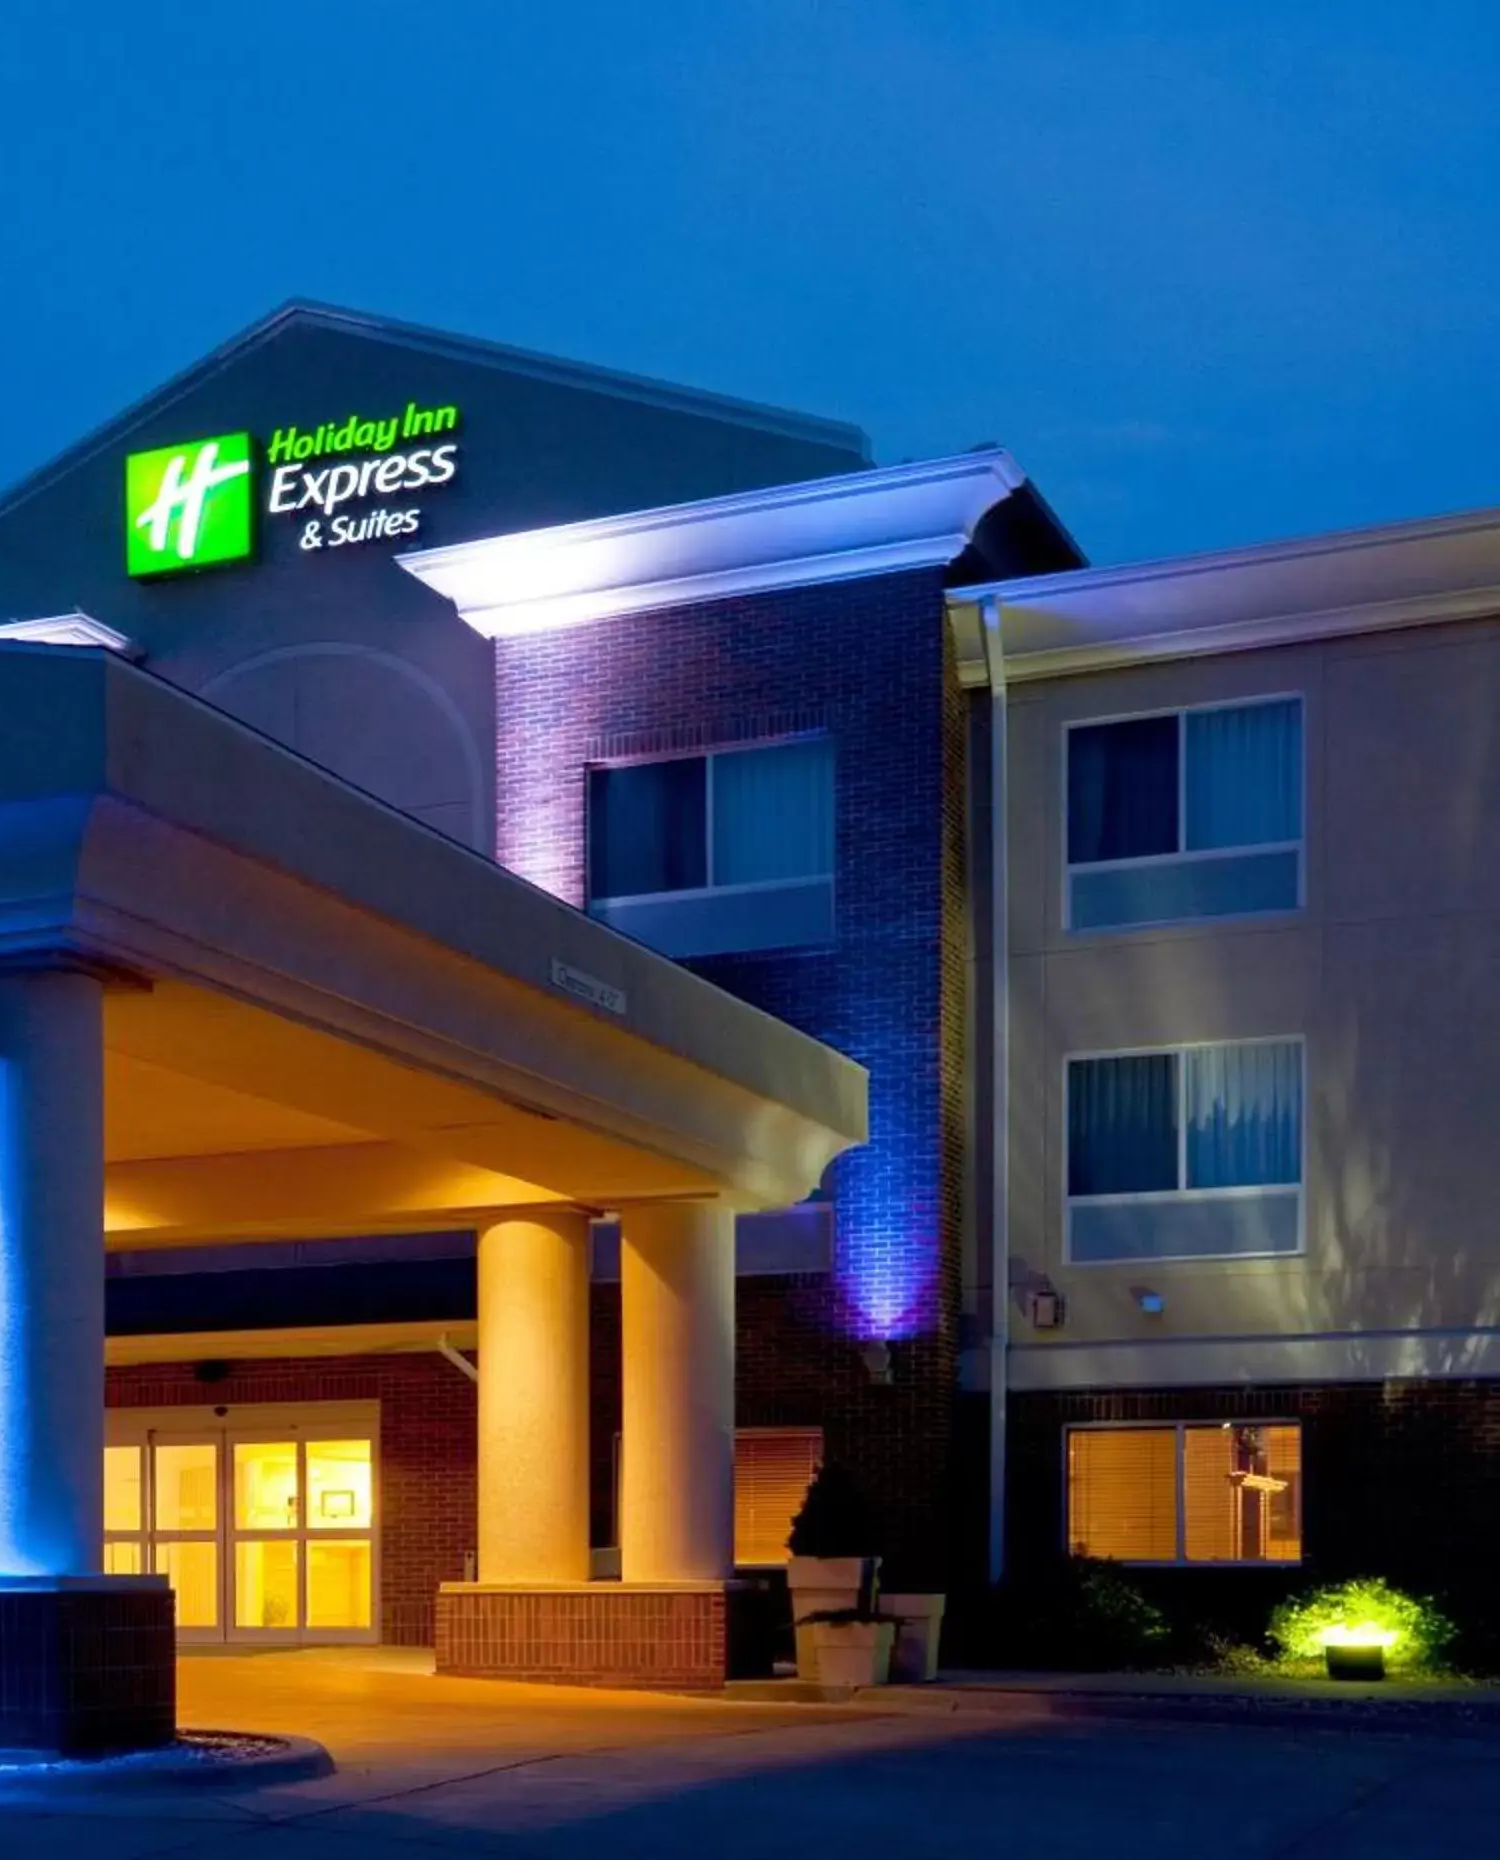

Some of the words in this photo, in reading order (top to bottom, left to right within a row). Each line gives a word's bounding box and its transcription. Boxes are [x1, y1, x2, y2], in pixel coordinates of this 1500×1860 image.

[267, 415, 399, 464] Holiday
[402, 402, 457, 438] Inn
[269, 445, 457, 515] Express
[299, 520, 322, 550] &
[328, 509, 420, 546] Suites
